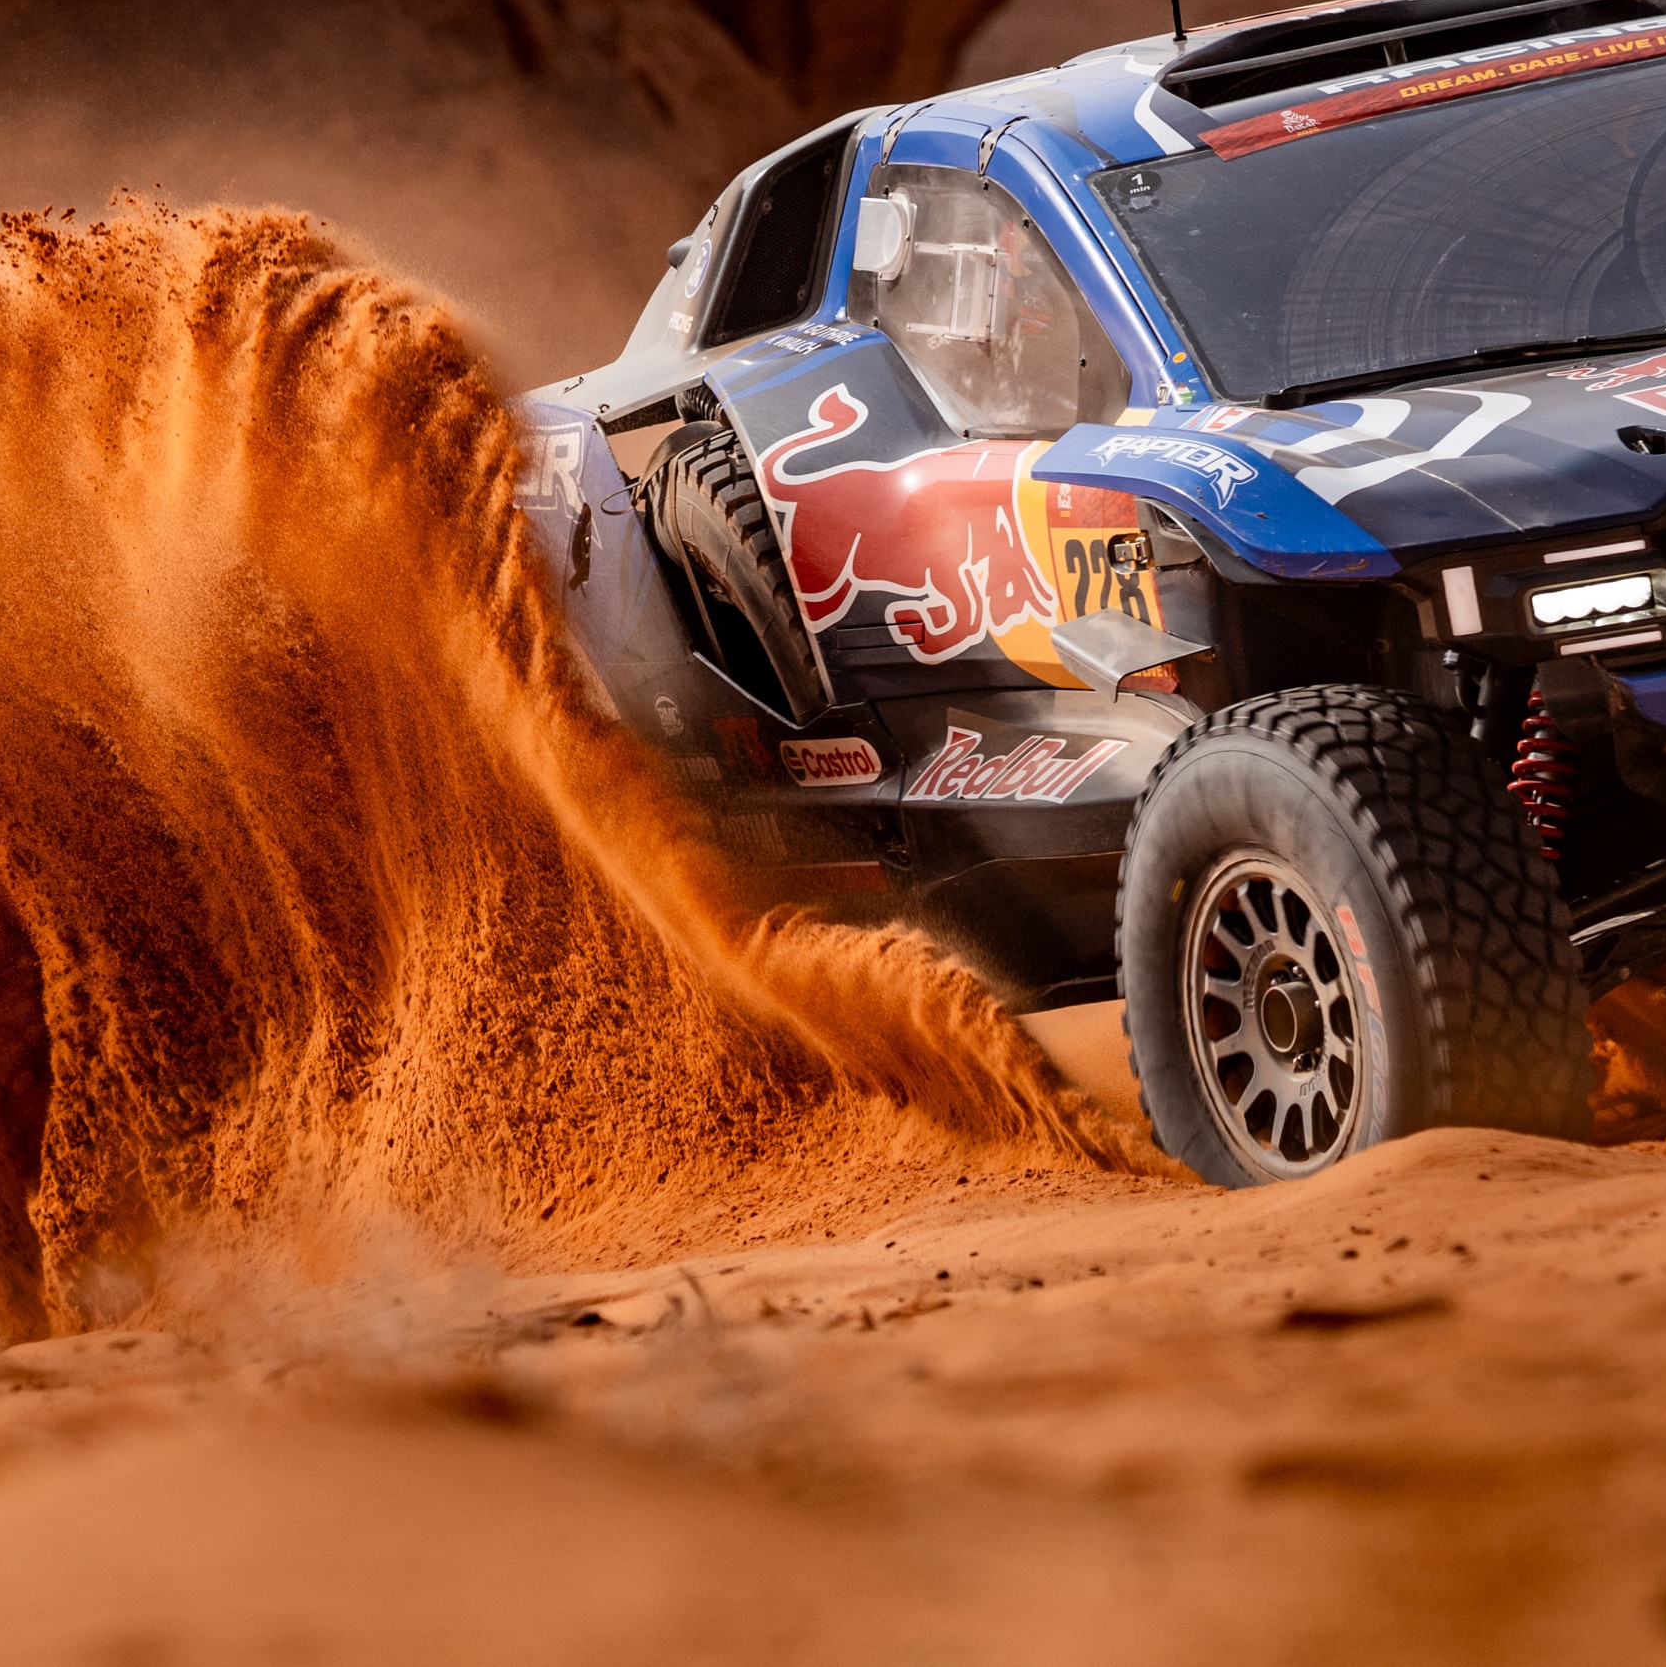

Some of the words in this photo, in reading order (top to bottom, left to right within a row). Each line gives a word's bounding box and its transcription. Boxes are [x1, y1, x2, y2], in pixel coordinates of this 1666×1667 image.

[1399, 68, 1505, 98] DREAM.
[1508, 51, 1589, 75] DARE.
[1593, 38, 1653, 58] LIVE
[1129, 184, 1151, 194] min
[1131, 172, 1144, 185] 1
[773, 335, 822, 355] WALCH
[803, 324, 861, 346] GUTHRIE
[1086, 434, 1259, 510] RAPTOR
[800, 744, 876, 779] Castrol
[901, 725, 1045, 801] Red
[980, 736, 1131, 804] Bull
